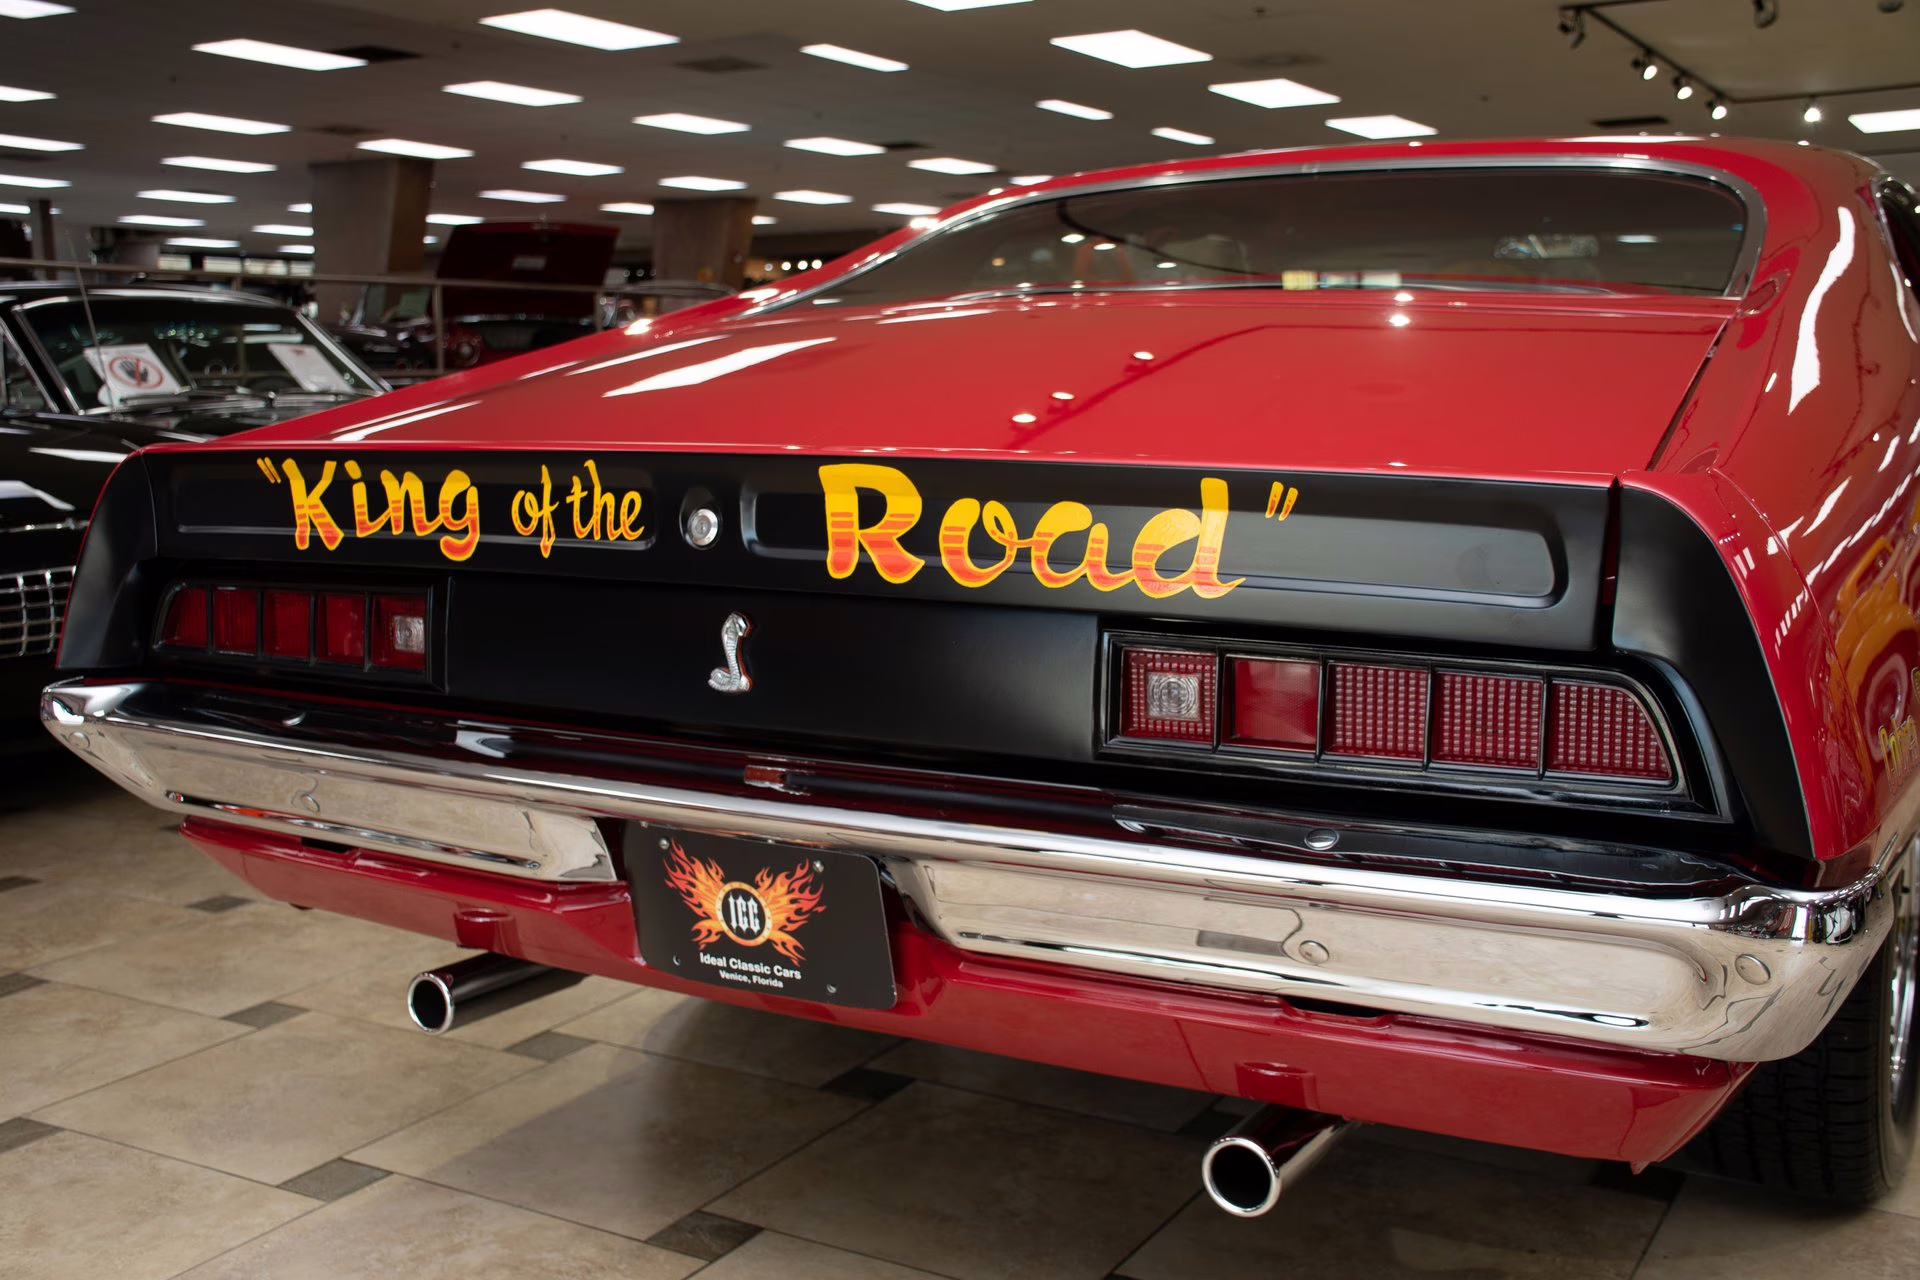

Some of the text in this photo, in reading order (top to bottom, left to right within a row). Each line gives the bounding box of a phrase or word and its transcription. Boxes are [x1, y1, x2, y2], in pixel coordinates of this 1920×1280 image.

[511, 464, 559, 558] of
[566, 459, 645, 541] the
[728, 892, 761, 935] ICC
[699, 952, 802, 980] Ideal Classic Cars
[719, 970, 784, 988] Venice, Florida
